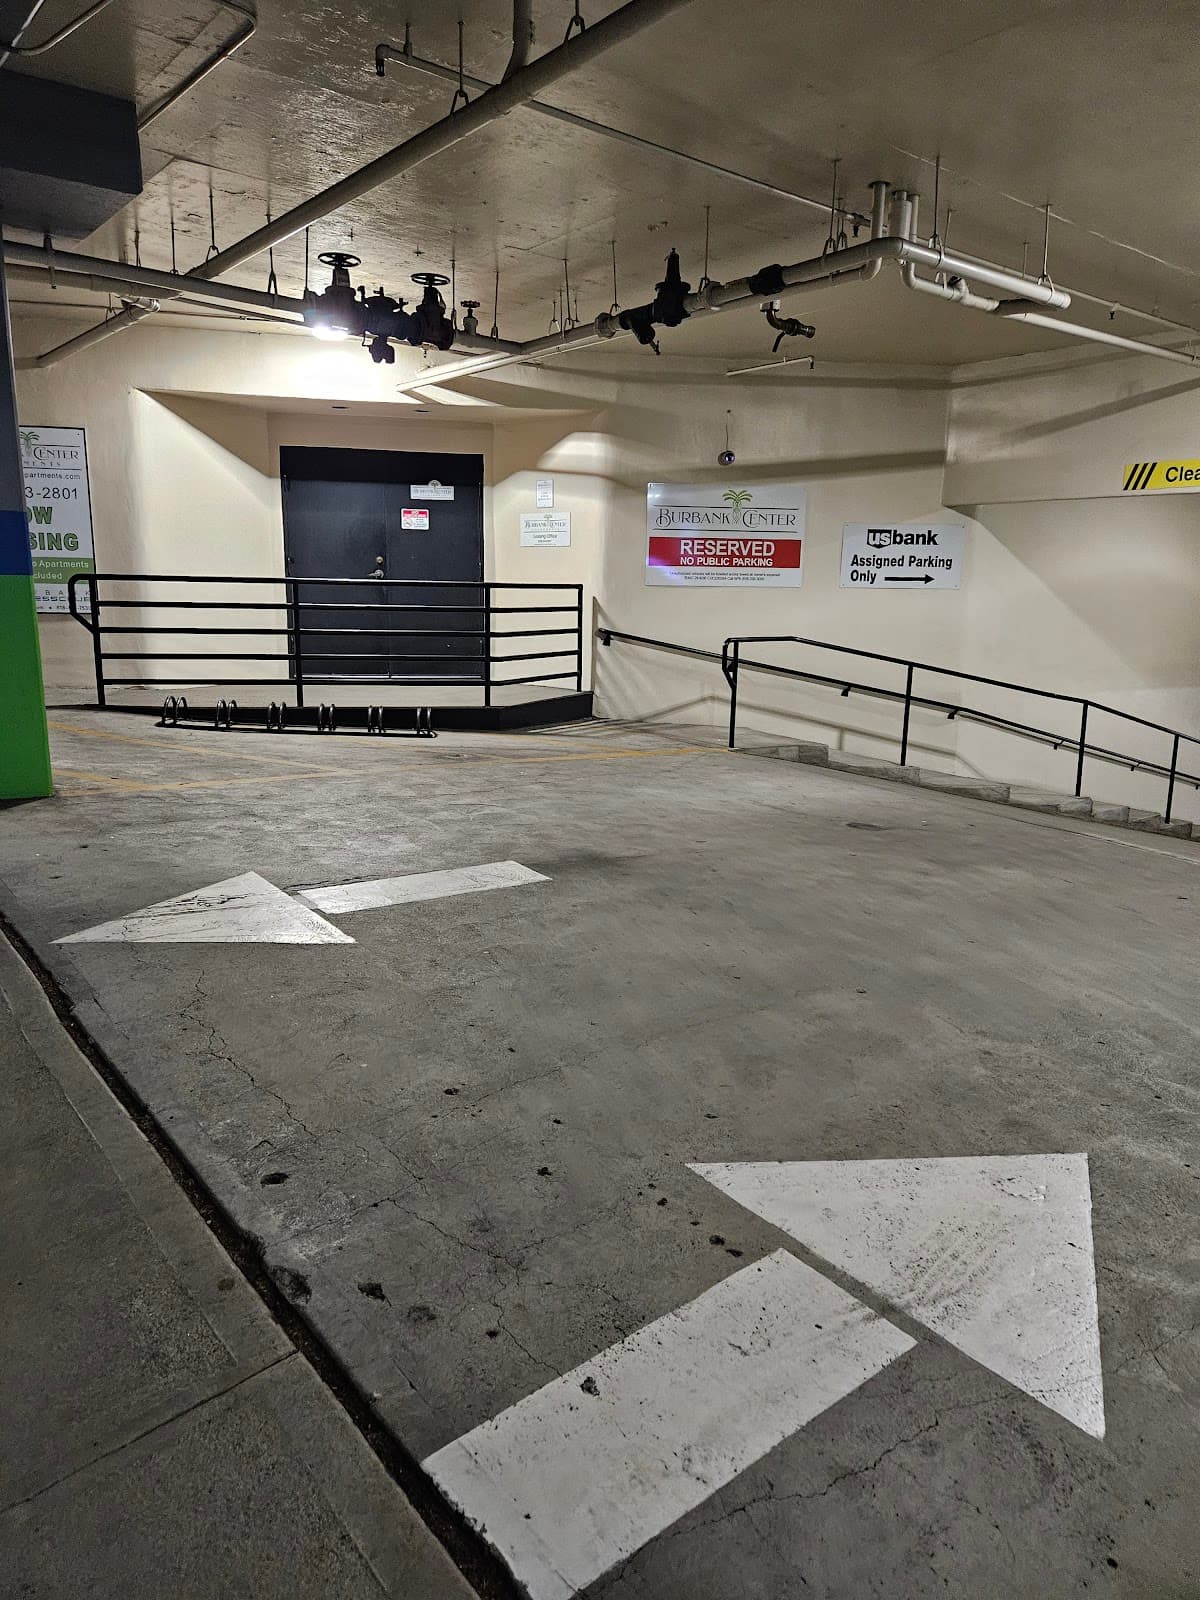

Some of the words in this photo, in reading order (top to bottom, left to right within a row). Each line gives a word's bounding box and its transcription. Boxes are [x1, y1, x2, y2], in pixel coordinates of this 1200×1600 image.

[33, 446, 79, 461] CENTER
[656, 508, 731, 528] BURBANK
[742, 510, 796, 529] CENTER
[680, 539, 775, 557] RESERVED
[39, 560, 89, 569] Apartments
[680, 556, 694, 566] NO
[697, 557, 730, 567] PUBLIC
[732, 557, 773, 567] PARKING
[850, 554, 905, 569] Assigned
[908, 555, 953, 570] Parking
[850, 569, 877, 585] Only
